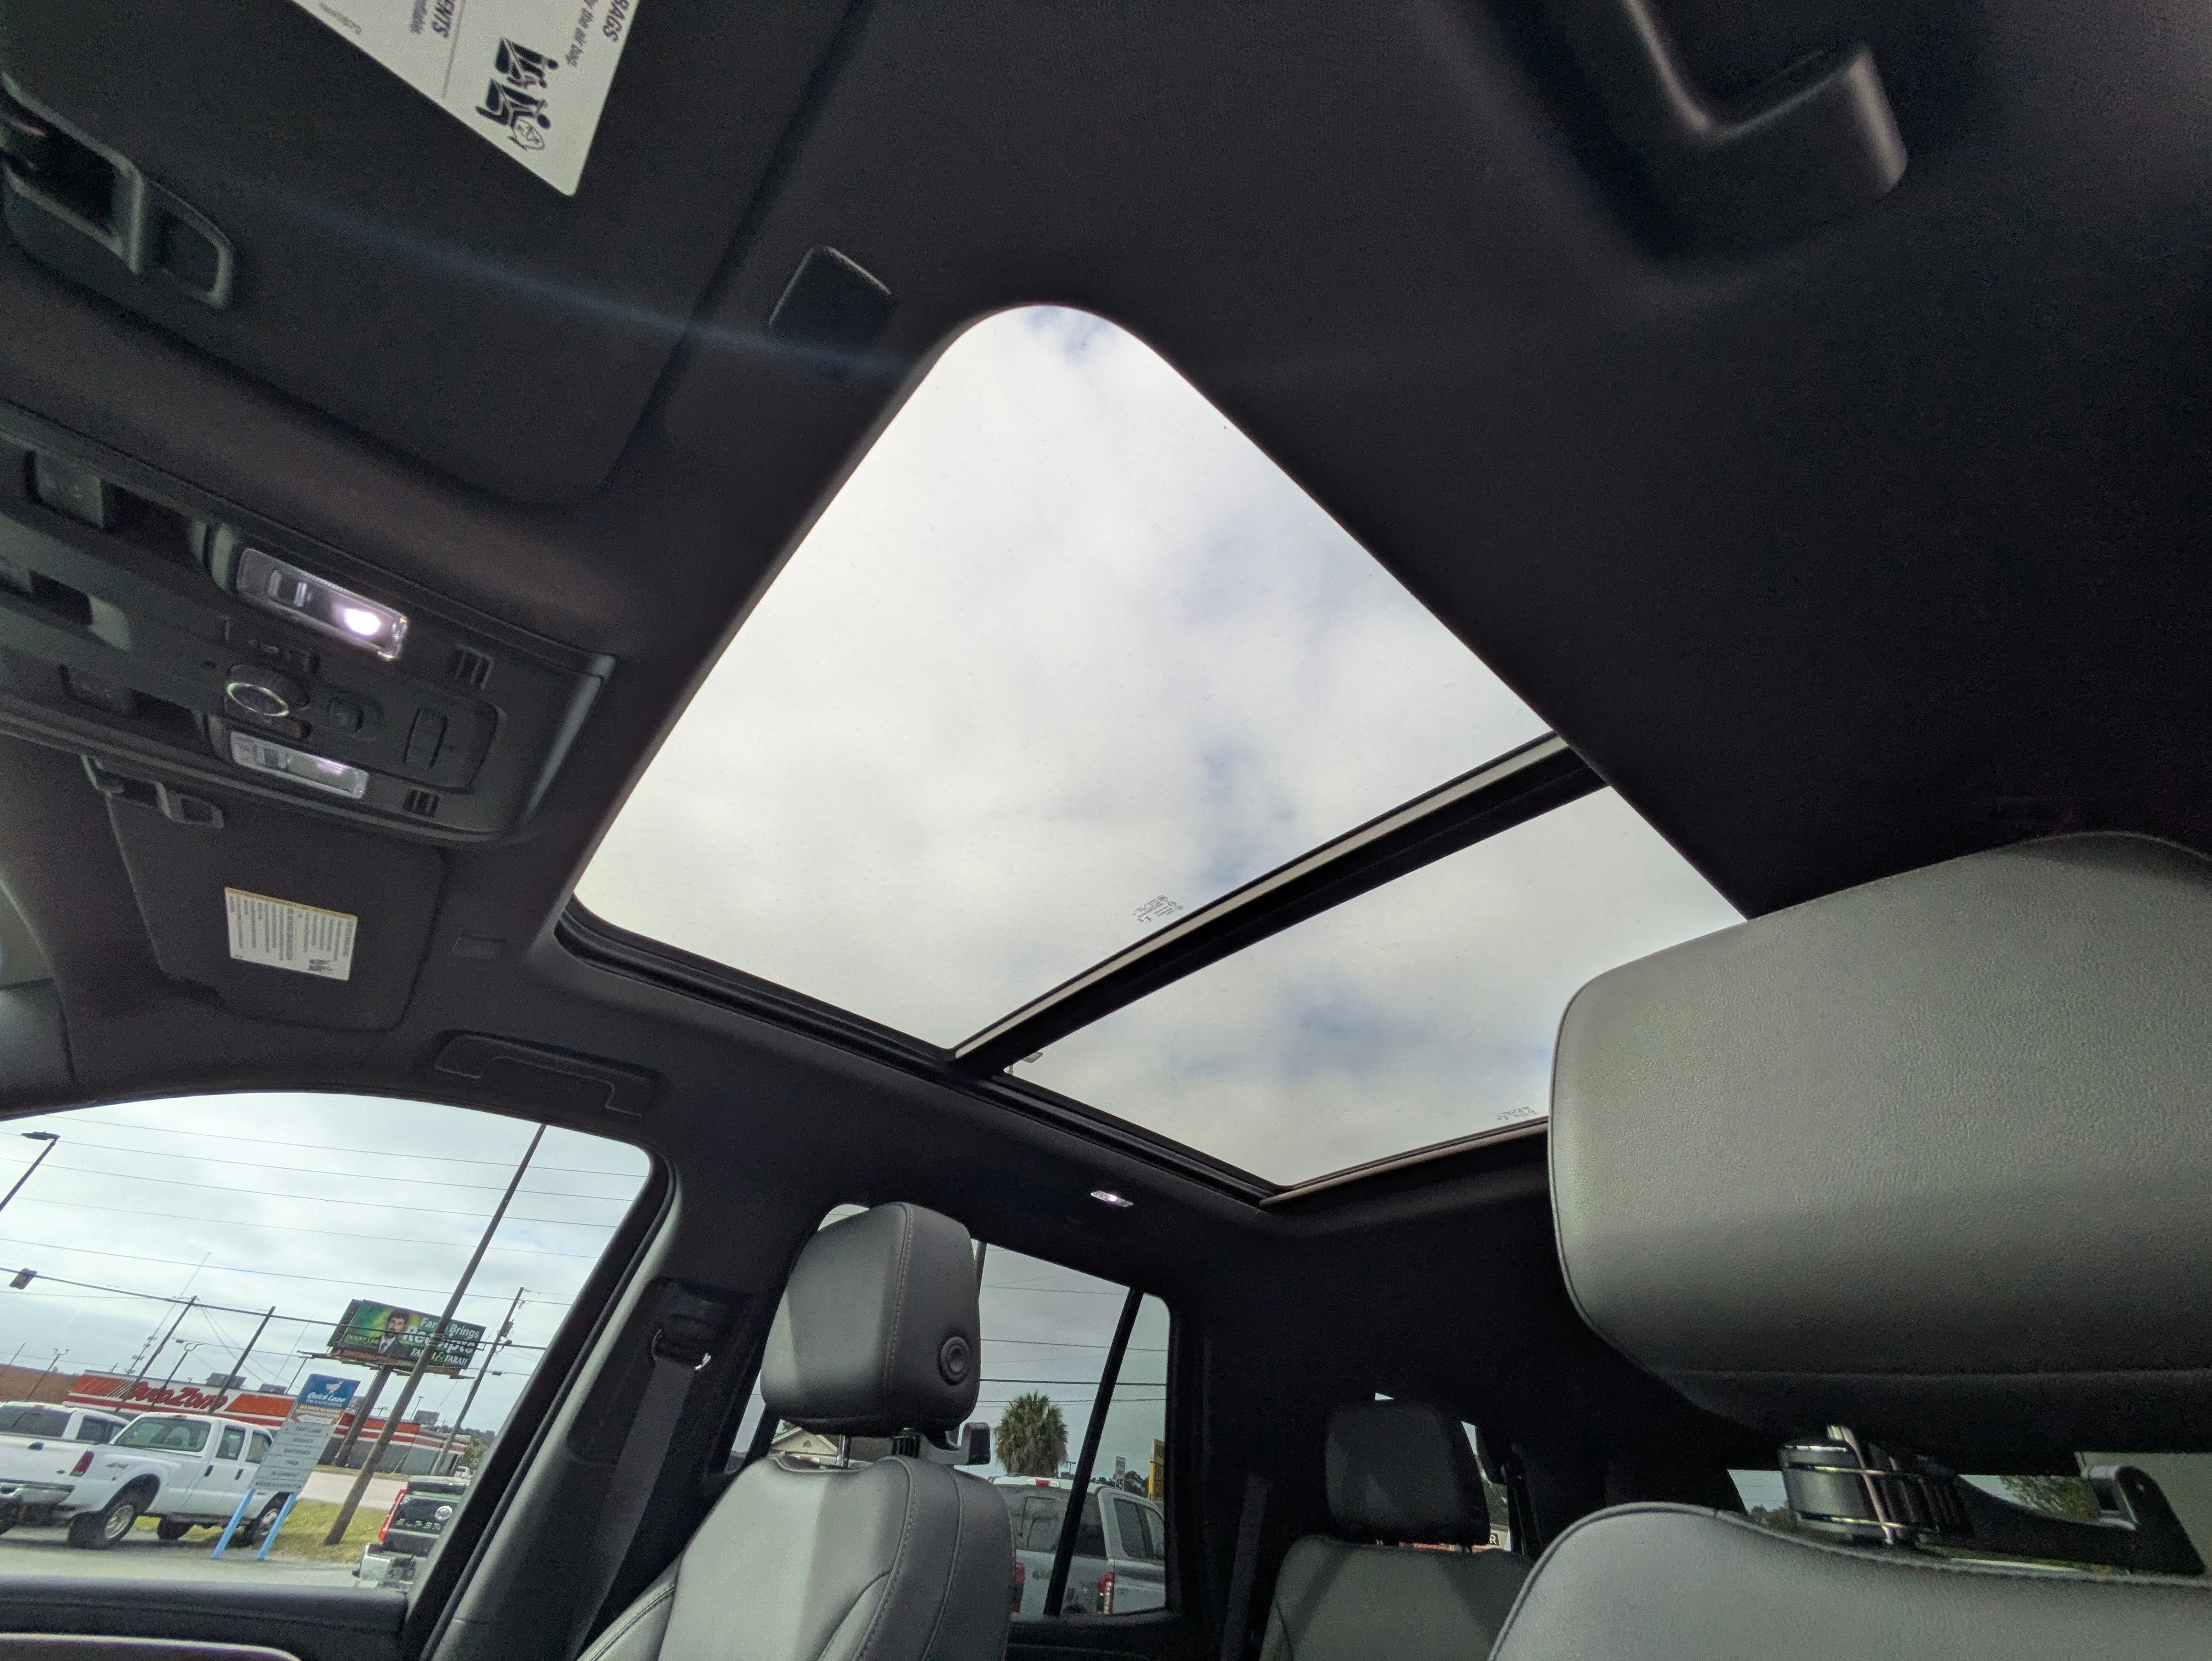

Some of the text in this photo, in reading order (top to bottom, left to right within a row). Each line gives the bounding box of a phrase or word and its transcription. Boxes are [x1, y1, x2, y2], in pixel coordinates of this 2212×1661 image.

[402, 1326, 476, 1353] Reipts
[449, 1324, 479, 1340] Brings
[444, 1354, 468, 1365] FARAH
